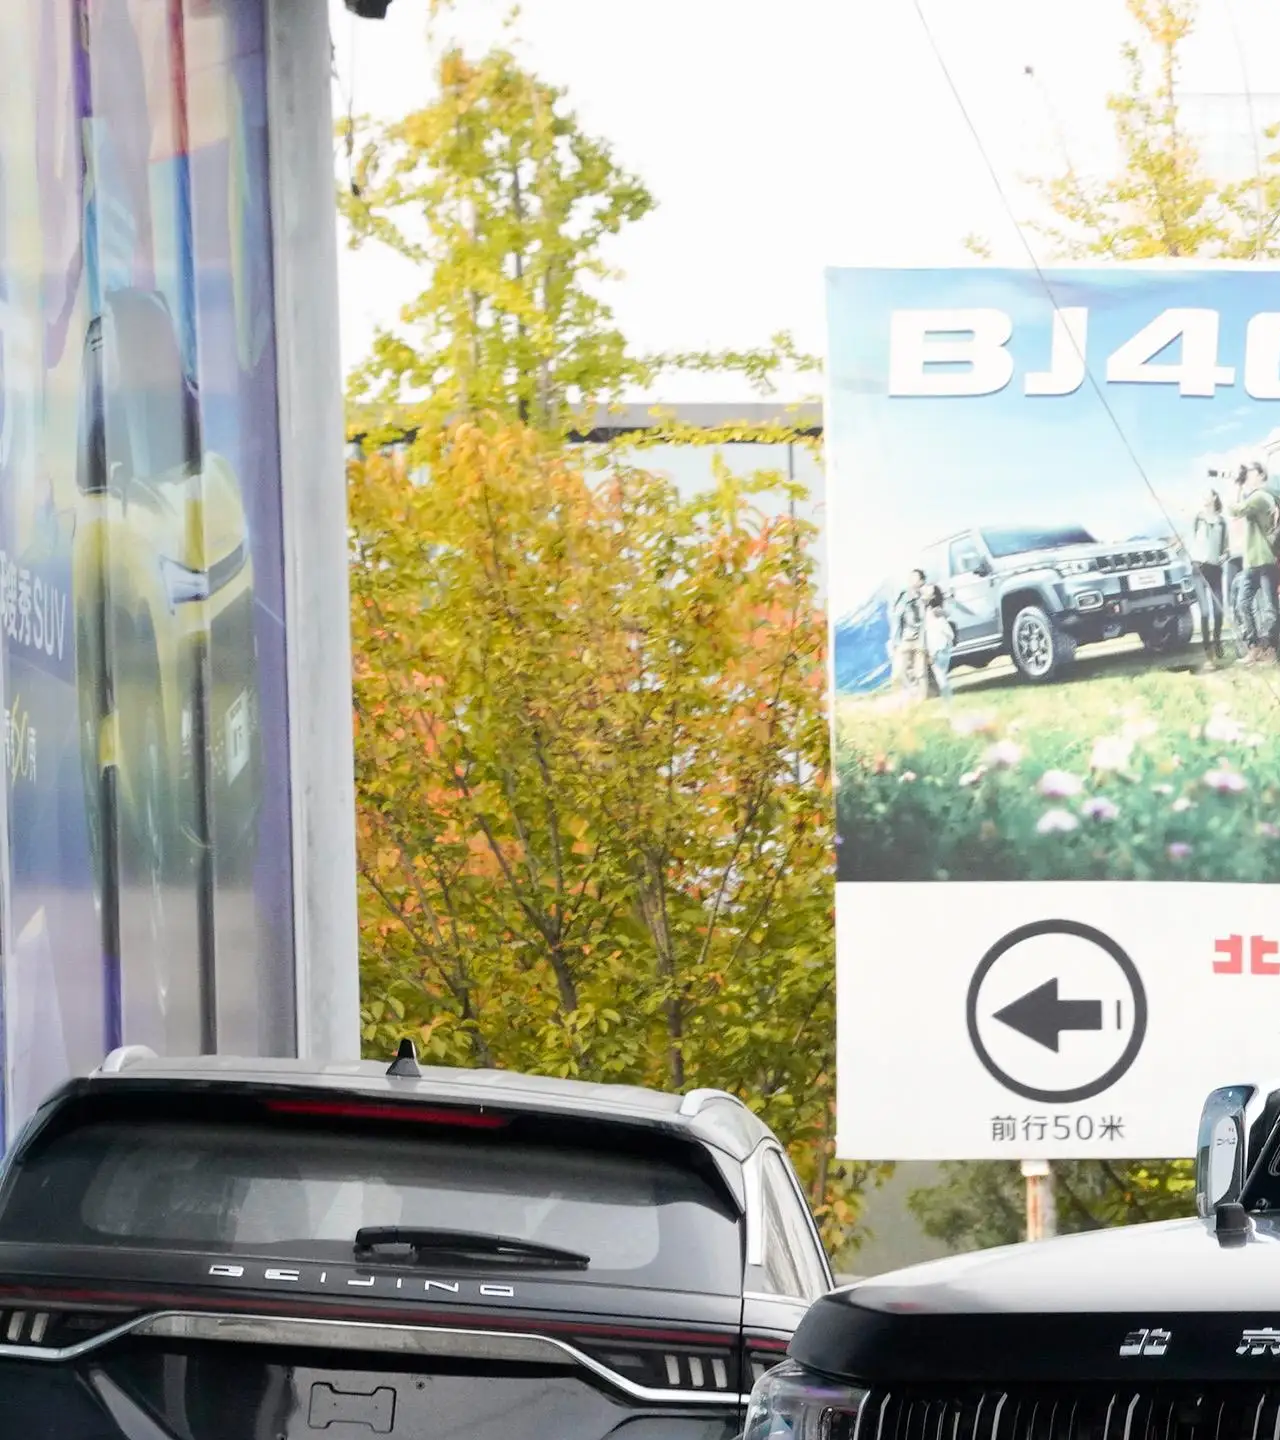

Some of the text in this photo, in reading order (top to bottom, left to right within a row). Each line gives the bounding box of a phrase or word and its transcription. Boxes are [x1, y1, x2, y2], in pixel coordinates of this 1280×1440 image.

[989, 1114, 1126, 1141] 前行50米
[208, 1264, 514, 1297] BEIJING
